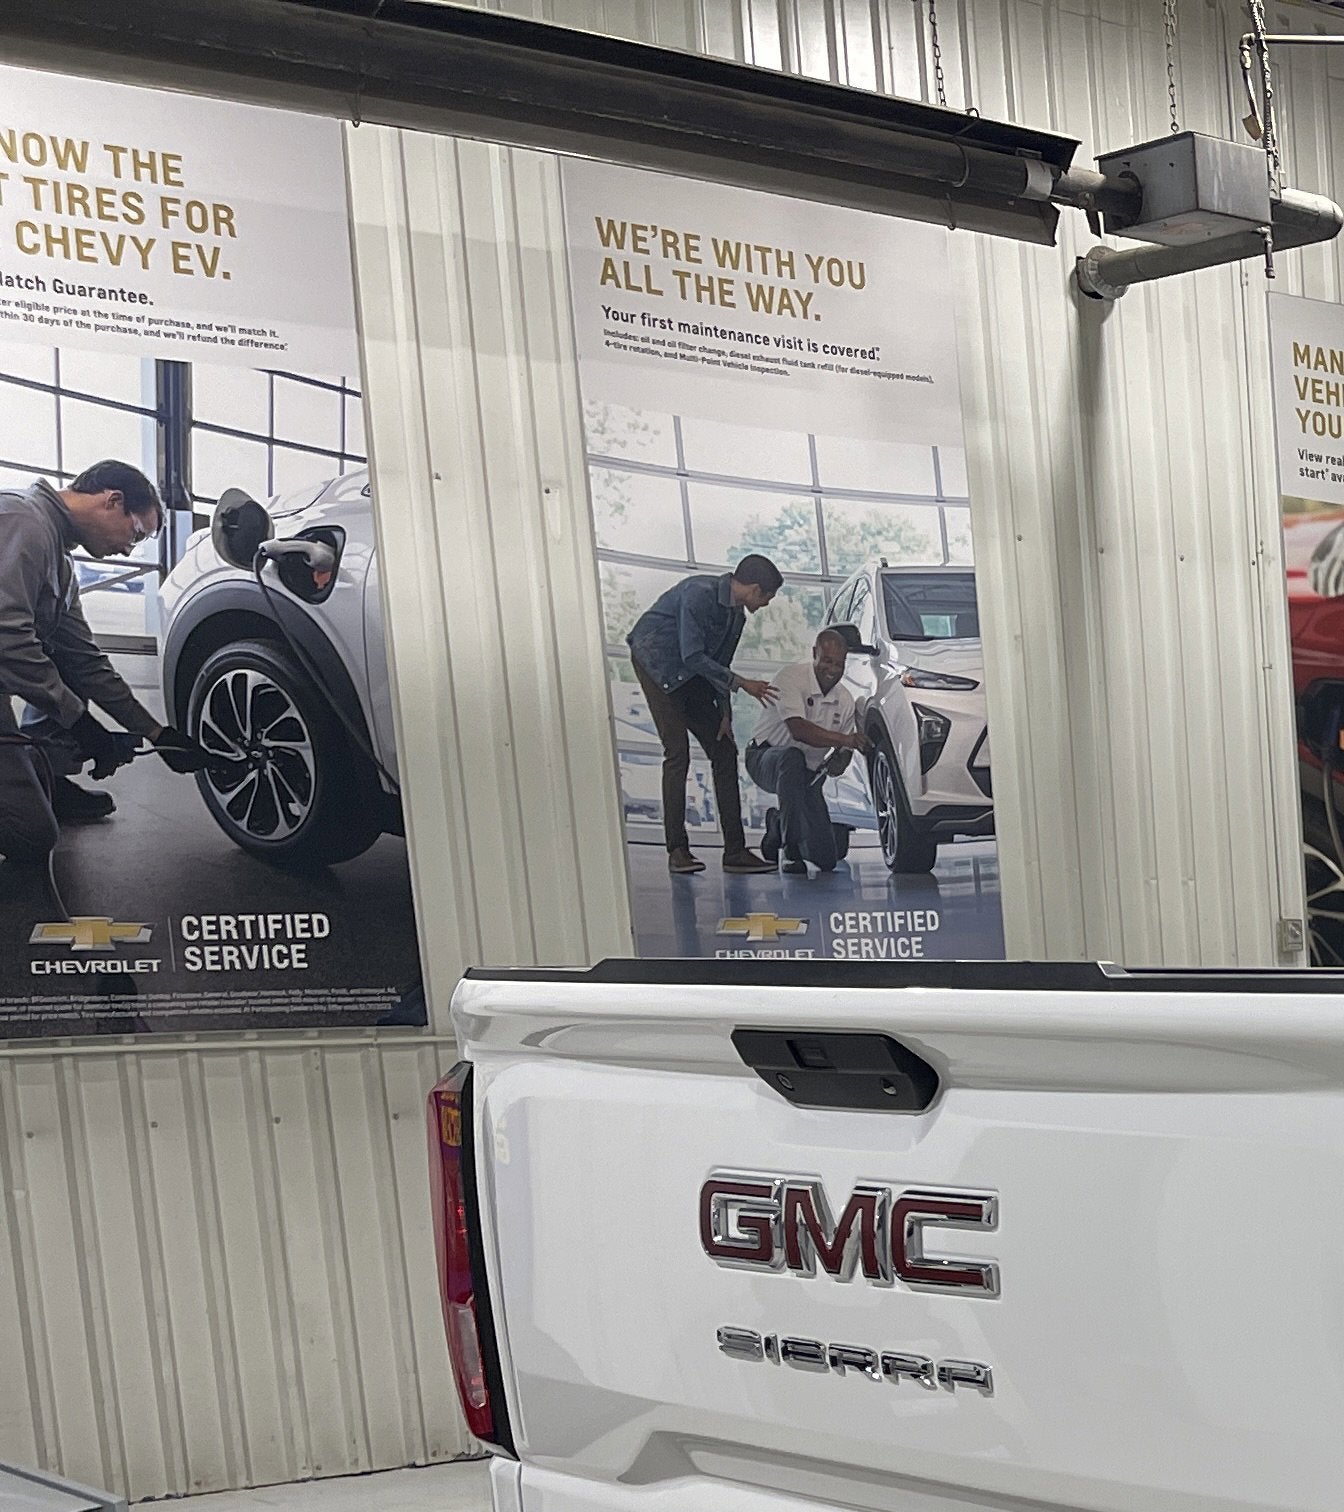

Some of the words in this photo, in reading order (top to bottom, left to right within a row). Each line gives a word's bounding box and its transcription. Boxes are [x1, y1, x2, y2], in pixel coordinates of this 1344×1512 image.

[103, 144, 184, 187] THE
[23, 176, 146, 225] TIRES
[160, 196, 237, 238] FOR
[15, 220, 157, 270] CHEVY
[171, 241, 231, 280] EV.
[595, 216, 702, 264] WE'RE
[711, 237, 796, 280] WITH
[804, 253, 866, 290] YOU
[0, 270, 46, 292] atch
[52, 278, 154, 306] Guarantee.
[600, 257, 664, 297] ALL
[672, 269, 737, 309] THE
[745, 281, 821, 322] WAY.
[22, 313, 34, 322] 30
[38, 316, 60, 327] days
[76, 320, 91, 330] the
[144, 329, 160, 338] and
[220, 336, 236, 346] the
[53, 305, 77, 316] price
[94, 310, 109, 320] the
[112, 312, 132, 322] time
[136, 315, 145, 323] of
[148, 317, 194, 330] purchase,
[196, 322, 213, 331] and
[239, 327, 267, 337] match
[601, 304, 636, 325] Your
[640, 312, 674, 331] first
[678, 321, 770, 346] maintenance
[773, 334, 803, 351] visit
[807, 338, 818, 353] is
[1297, 448, 1323, 464] View
[181, 913, 330, 941] CERTIFIED
[829, 910, 939, 934] CERTIFIED
[184, 943, 309, 972] SERVICE
[831, 936, 925, 959] SERVICE
[31, 959, 161, 974] CHEVROLET
[700, 1168, 1001, 1301] GMC
[716, 1326, 995, 1399] SIERRA
